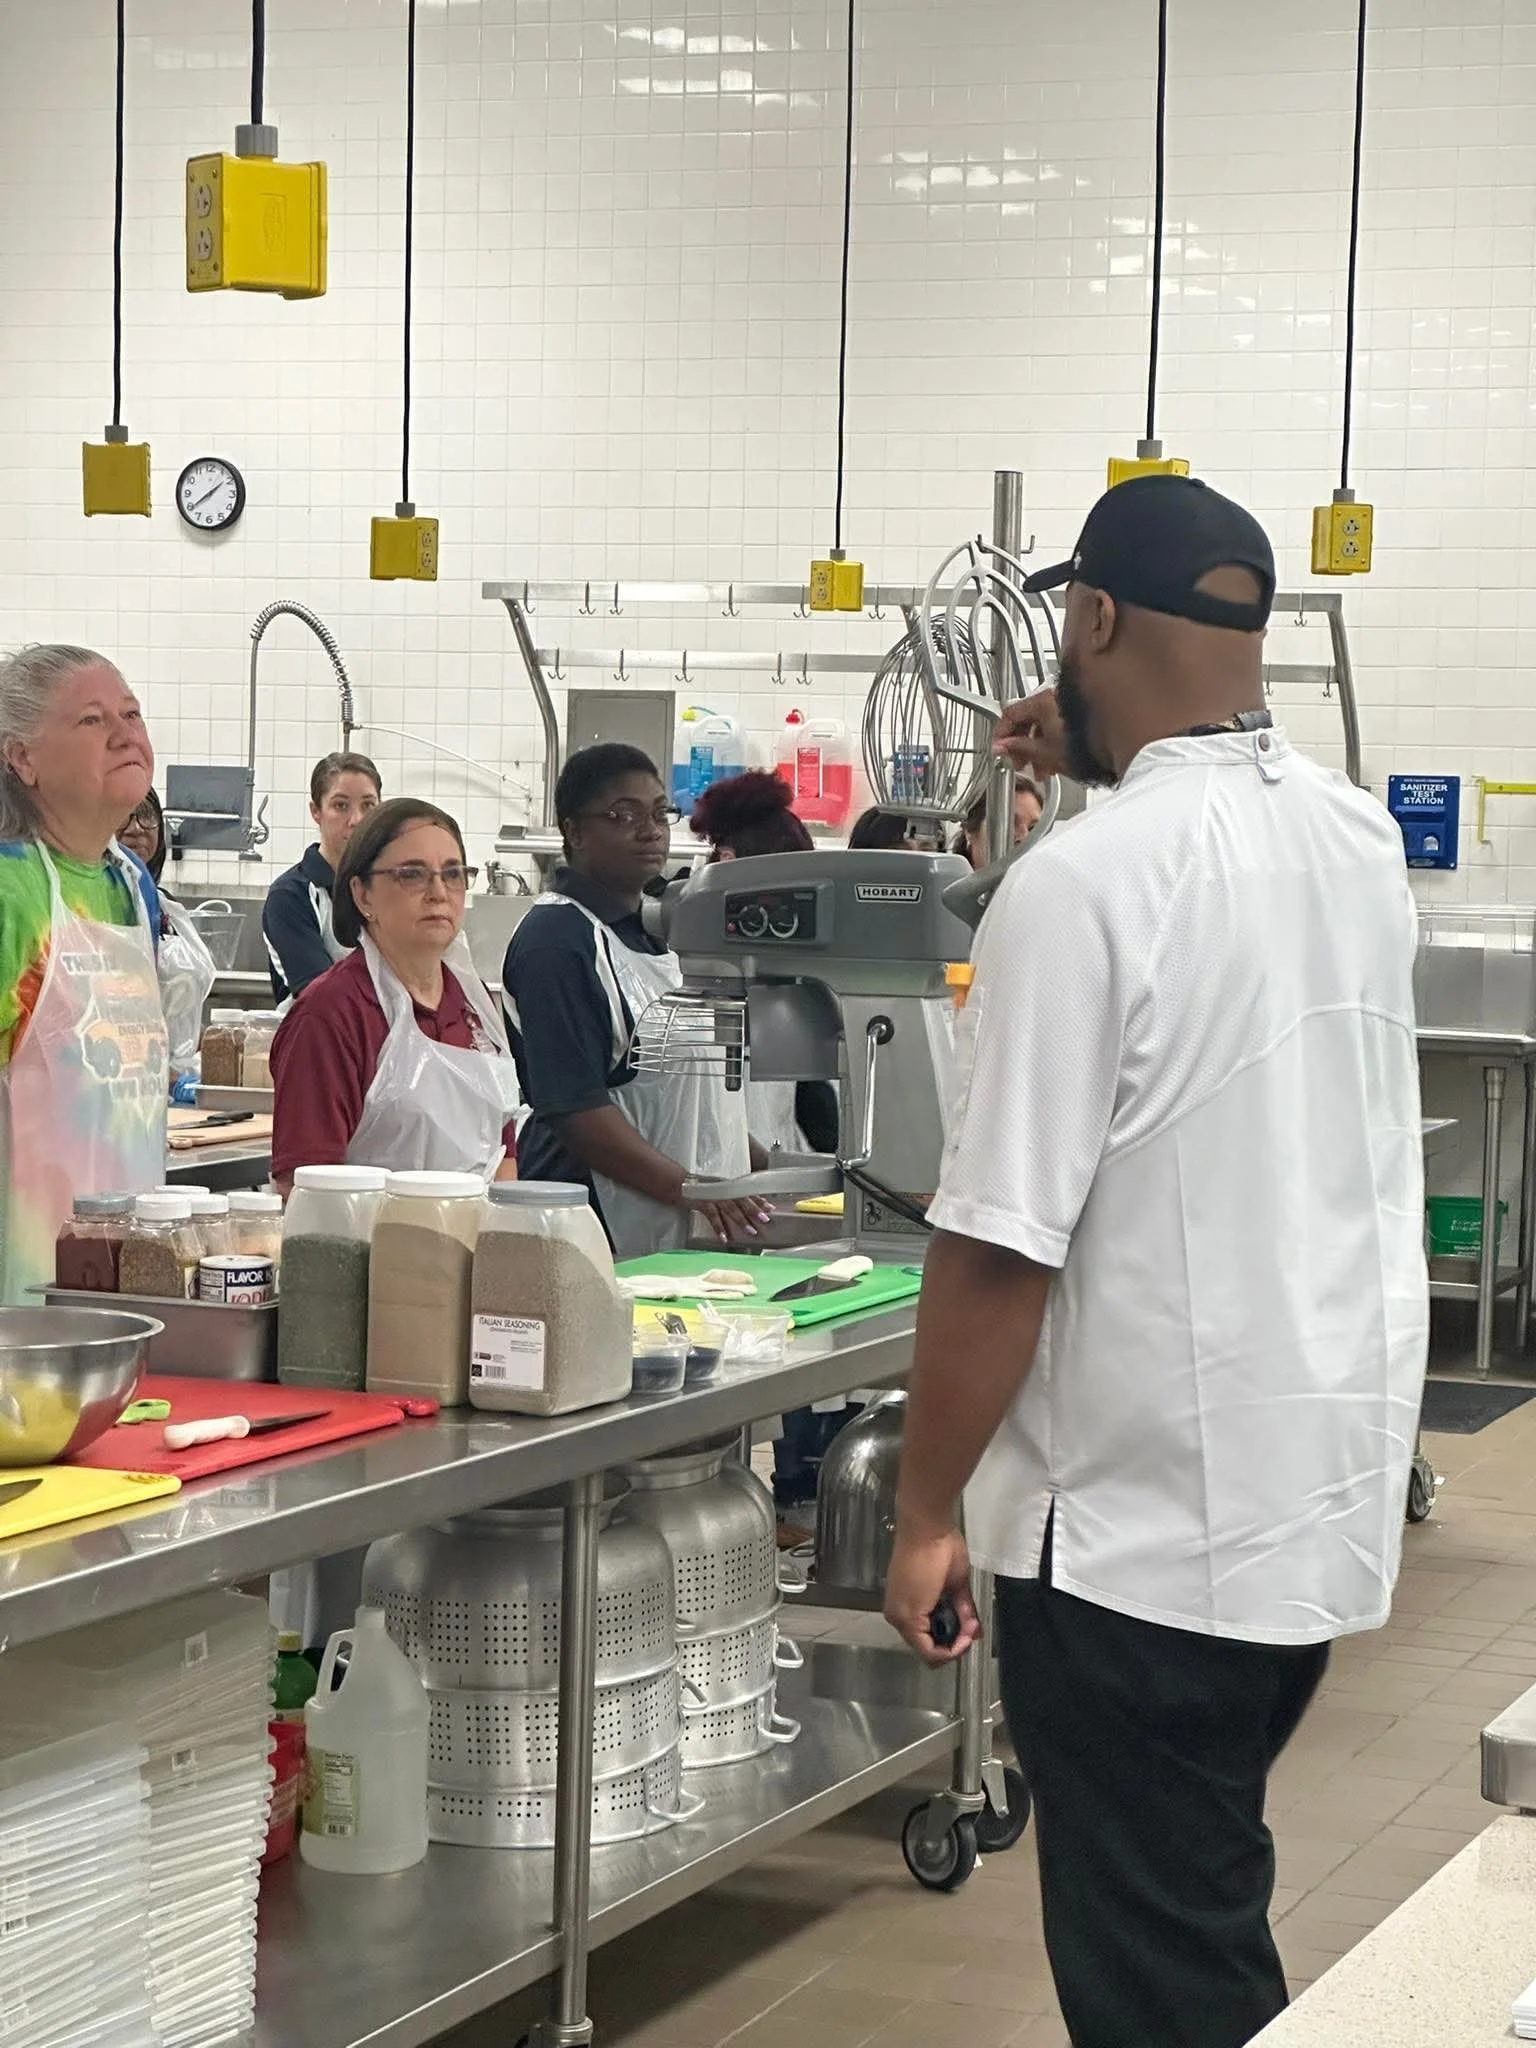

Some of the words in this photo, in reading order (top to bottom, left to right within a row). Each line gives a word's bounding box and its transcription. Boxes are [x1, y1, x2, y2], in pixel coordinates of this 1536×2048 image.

[206, 464, 216, 472] 12
[184, 489, 192, 498] 9
[228, 489, 236, 499] 3
[195, 512, 202, 521] 7
[205, 515, 213, 524] 6
[217, 512, 225, 521] 5
[1400, 783, 1448, 792] SANITIZER
[1412, 790, 1435, 798] TEST
[1403, 797, 1444, 805] STATION
[862, 888, 916, 897] HOBART
[226, 1270, 264, 1284] FLAVOR
[479, 1316, 502, 1327] ITALIAN
[504, 1319, 540, 1330] SEASONING
